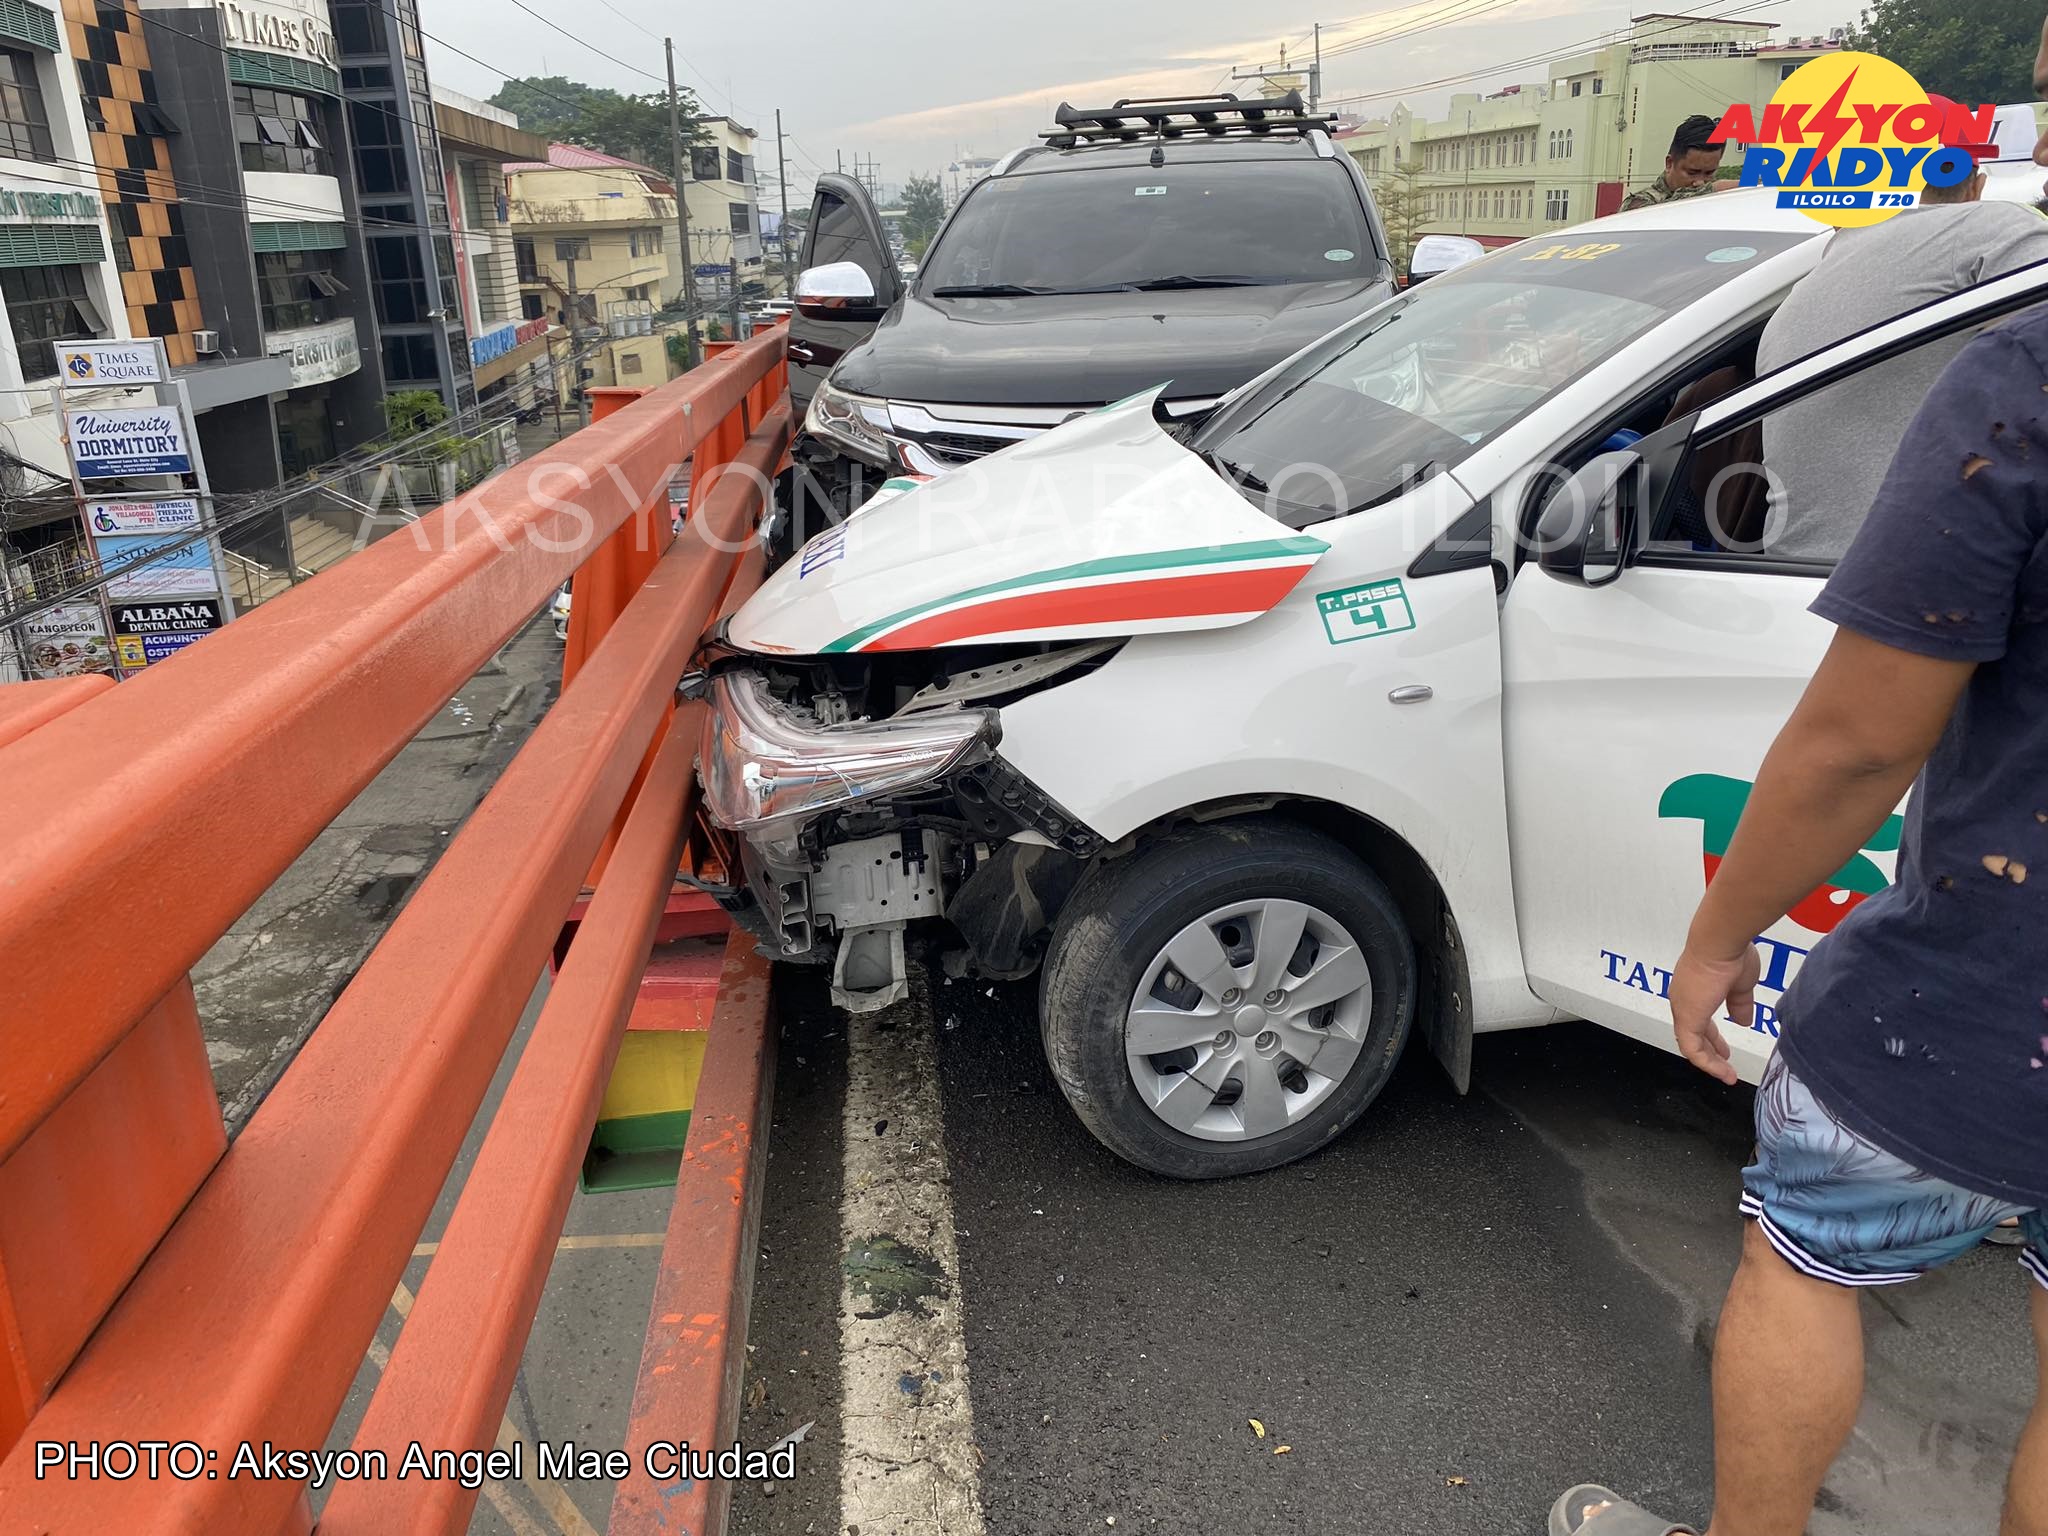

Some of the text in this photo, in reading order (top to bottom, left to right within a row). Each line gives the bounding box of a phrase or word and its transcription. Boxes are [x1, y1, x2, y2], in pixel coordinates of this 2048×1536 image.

[214, 0, 299, 52] TIMES
[95, 352, 139, 365] TIMES
[100, 365, 155, 380] SQUARE
[76, 415, 172, 436] University
[77, 435, 178, 458] DORMITORY
[156, 501, 193, 509] PHYSICAL
[157, 508, 194, 517] THERAPY
[158, 515, 195, 523] CLINIC
[1341, 584, 1401, 606] PASS
[119, 602, 214, 623] ALBAÑA
[1349, 604, 1388, 630] 4
[28, 622, 96, 634] KANGBYEON
[129, 618, 209, 632] DENTAL CLINIC
